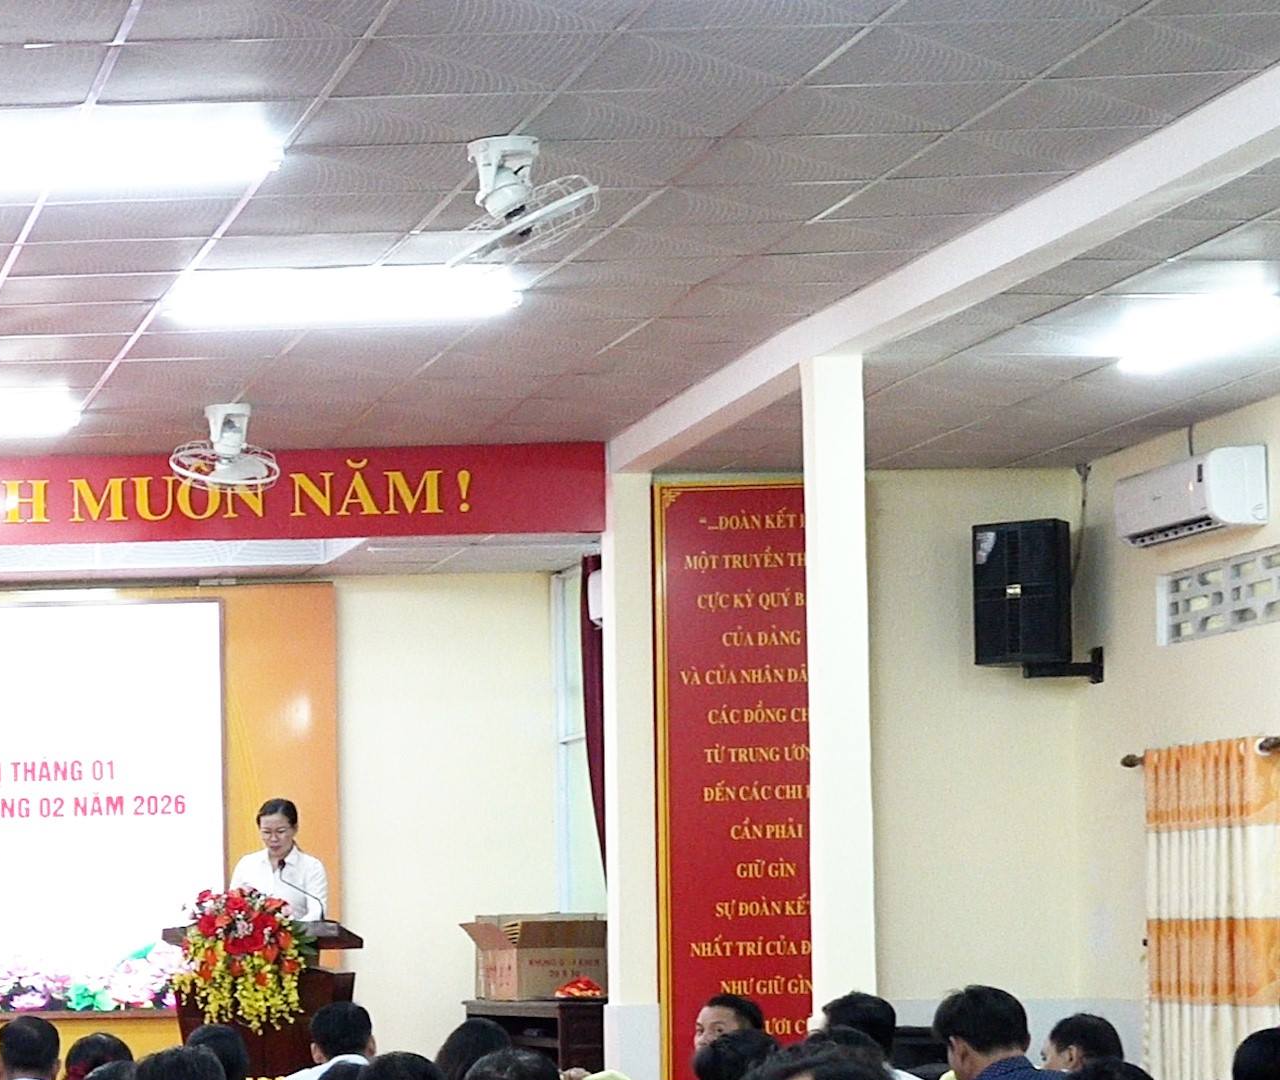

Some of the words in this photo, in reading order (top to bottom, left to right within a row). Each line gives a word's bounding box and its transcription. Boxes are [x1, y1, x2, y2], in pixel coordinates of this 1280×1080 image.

[68, 461, 266, 523] MUÔN
[765, 507, 797, 529] KẾT
[684, 550, 720, 574] MỘT
[722, 546, 784, 569] TRUYỀN
[697, 592, 730, 613] CỰC
[759, 587, 790, 611] QUÝ
[722, 625, 754, 647] CỦA
[758, 624, 801, 646] ĐẢNG
[680, 665, 701, 685] VÀ
[705, 664, 737, 684] CỦA
[740, 664, 785, 684] NHÂN
[787, 664, 809, 683] DÂ
[707, 704, 740, 724] CÁC
[743, 700, 787, 723] ĐỒNG
[790, 707, 809, 722] CH
[704, 744, 725, 763] TỪ
[728, 747, 780, 763] TRUNG
[92, 760, 114, 781] 01
[703, 780, 737, 802] ĐẾN
[739, 780, 772, 801] CÁC
[774, 784, 803, 800] CHI
[39, 797, 65, 818] 02
[74, 792, 124, 817] NĂM
[133, 794, 186, 816] 2026
[730, 817, 763, 840] CẦN
[766, 817, 803, 839] PHẢI
[736, 859, 766, 878] GIỮ
[768, 857, 797, 878] GÌN
[715, 899, 736, 920] SỰ
[738, 895, 782, 917] ĐOÀN
[784, 893, 810, 916] KẾ
[690, 934, 734, 957] NHẤT
[736, 935, 764, 956] TRÍ
[765, 934, 797, 956] CỦA
[720, 977, 755, 995] NHƯ
[756, 976, 786, 995] GIỮ
[764, 1018, 790, 1035] ƯƠI
